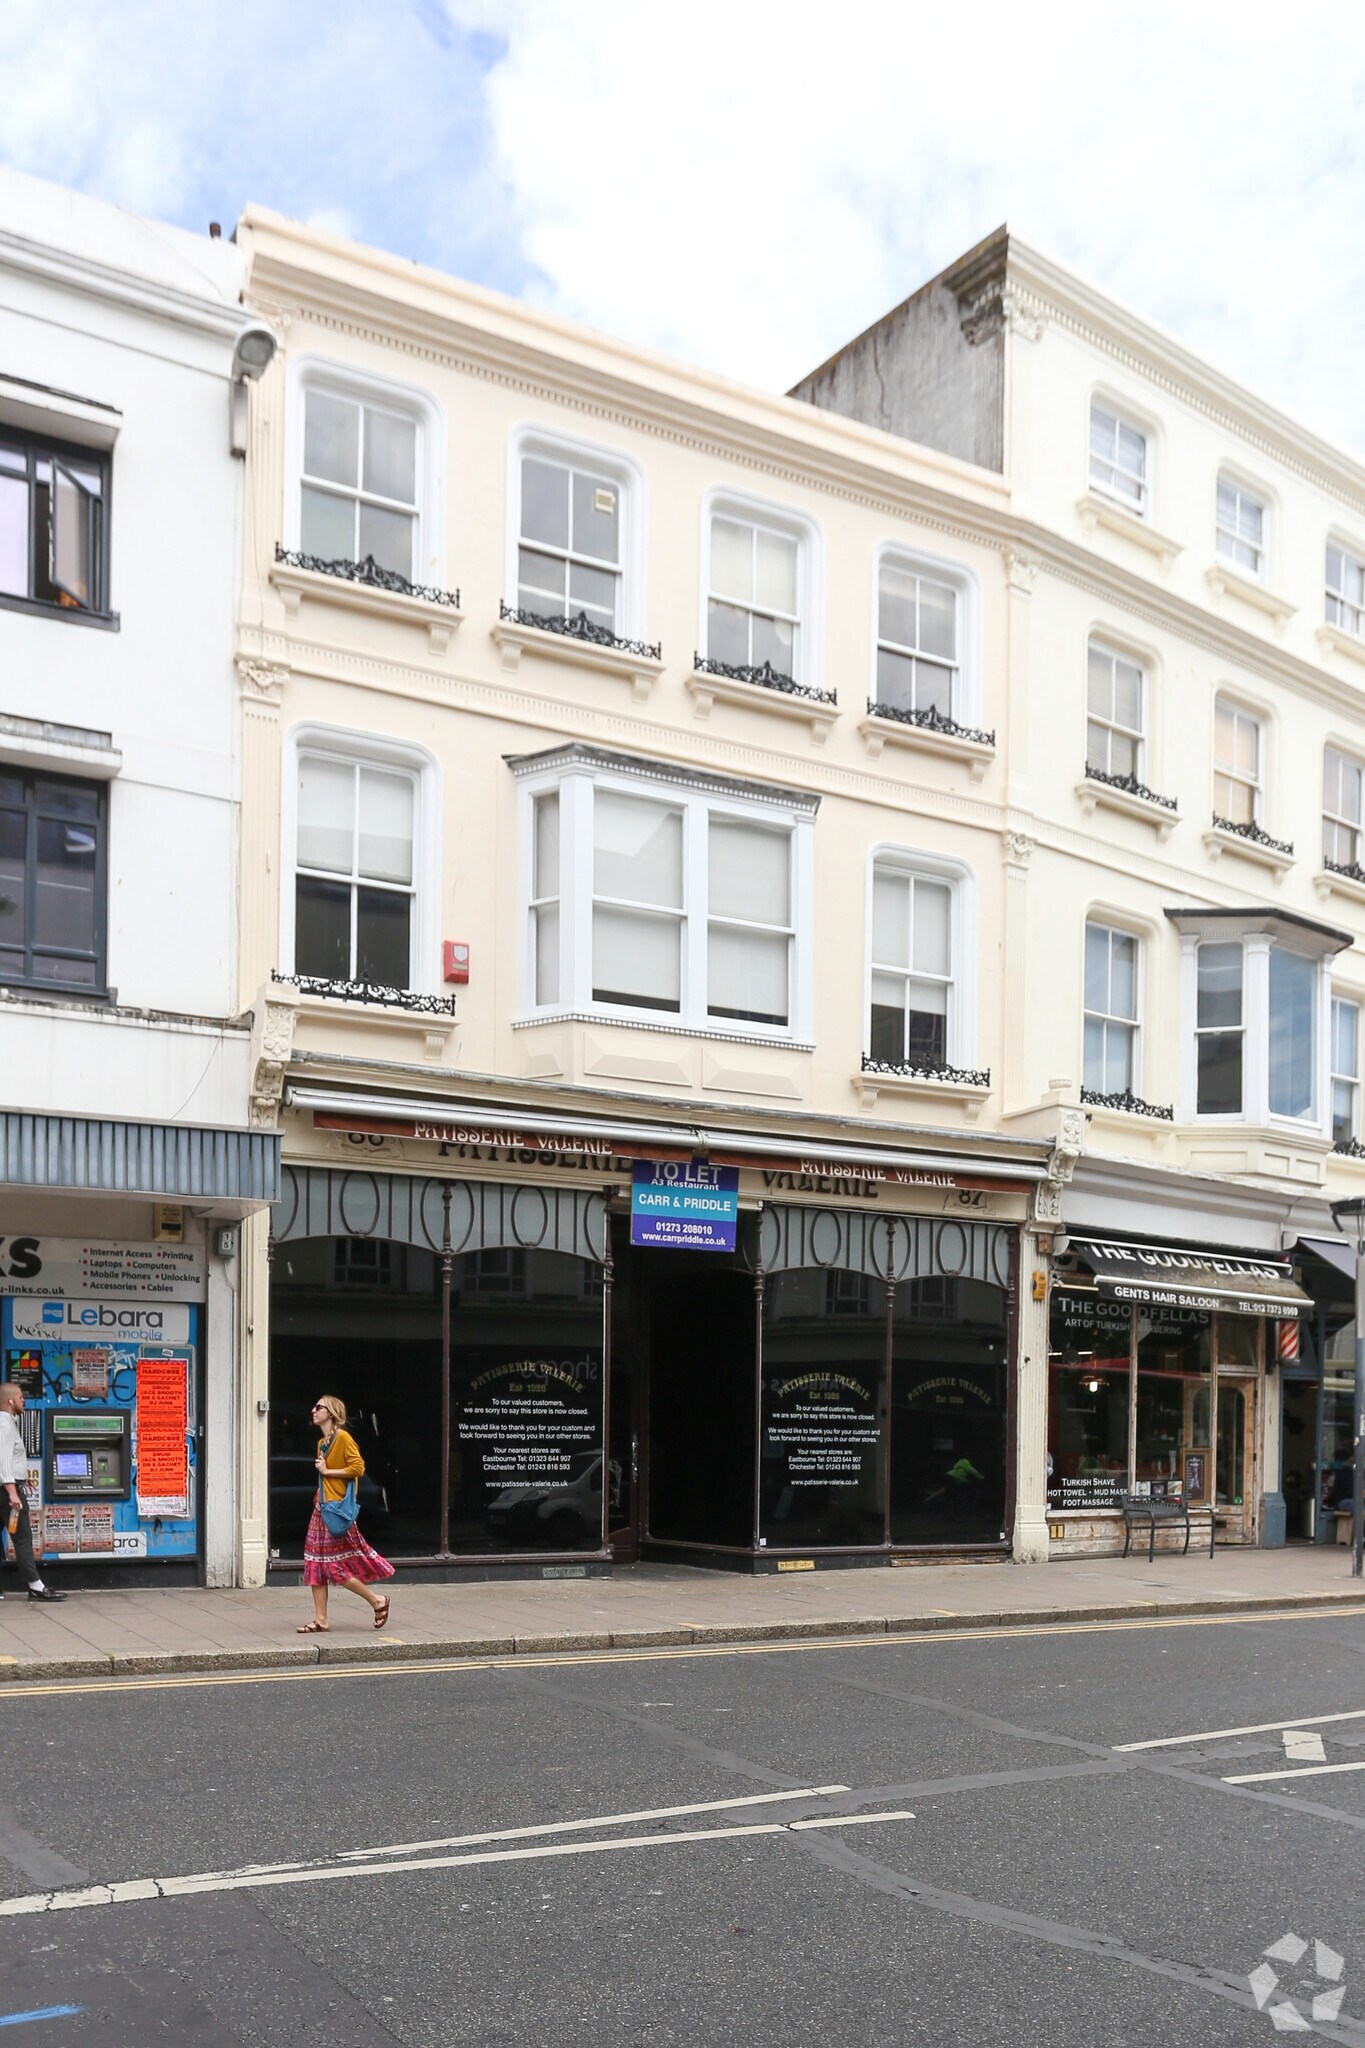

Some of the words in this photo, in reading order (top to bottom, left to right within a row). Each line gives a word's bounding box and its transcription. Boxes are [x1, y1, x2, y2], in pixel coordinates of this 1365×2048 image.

[414, 1121, 524, 1146] PATISSERIE
[537, 1134, 612, 1155] VALERIE
[652, 1161, 679, 1180] TO
[685, 1163, 722, 1184] LET
[800, 1158, 886, 1180] PATISSERIE
[895, 1168, 956, 1187] VALERIE
[667, 1180, 719, 1190] Restaurant
[638, 1194, 670, 1206] CARR
[673, 1197, 680, 1208] &
[684, 1198, 731, 1212] PRIDDLE
[655, 1222, 681, 1232] 01273
[682, 1224, 712, 1234] 208010
[642, 1232, 726, 1245] www.carrpriddle.co.uk
[90, 1248, 124, 1257] Internet
[126, 1250, 152, 1258] Access
[162, 1252, 194, 1261] Printing
[1089, 1244, 1136, 1261] THE
[90, 1260, 122, 1268] Laptops
[132, 1261, 176, 1270] Computers
[90, 1270, 120, 1278] Mobile
[121, 1272, 151, 1280] Phones
[160, 1274, 200, 1283] Unlocking
[90, 1282, 138, 1290] Accessories
[147, 1284, 174, 1292] Cables
[1058, 1298, 1094, 1314] THE
[1114, 1286, 1150, 1300] GENTS
[1152, 1290, 1177, 1304] HAIR
[1179, 1294, 1219, 1308] SALOON
[1266, 1304, 1282, 1314] 7373
[67, 1304, 163, 1328] Lebara
[1065, 1318, 1081, 1326] ART
[1084, 1320, 1094, 1328] OF
[1096, 1320, 1130, 1330] TURKISH
[118, 1328, 162, 1340] mobile
[470, 1362, 535, 1390] PATISSERIE
[540, 1364, 584, 1392] VALERIE
[778, 1372, 830, 1398] PATISSERIE
[834, 1375, 870, 1400] VALERIE
[506, 1432, 525, 1440] seeing
[1062, 1478, 1092, 1486] TURKISH
[1093, 1478, 1115, 1486] SHAVE
